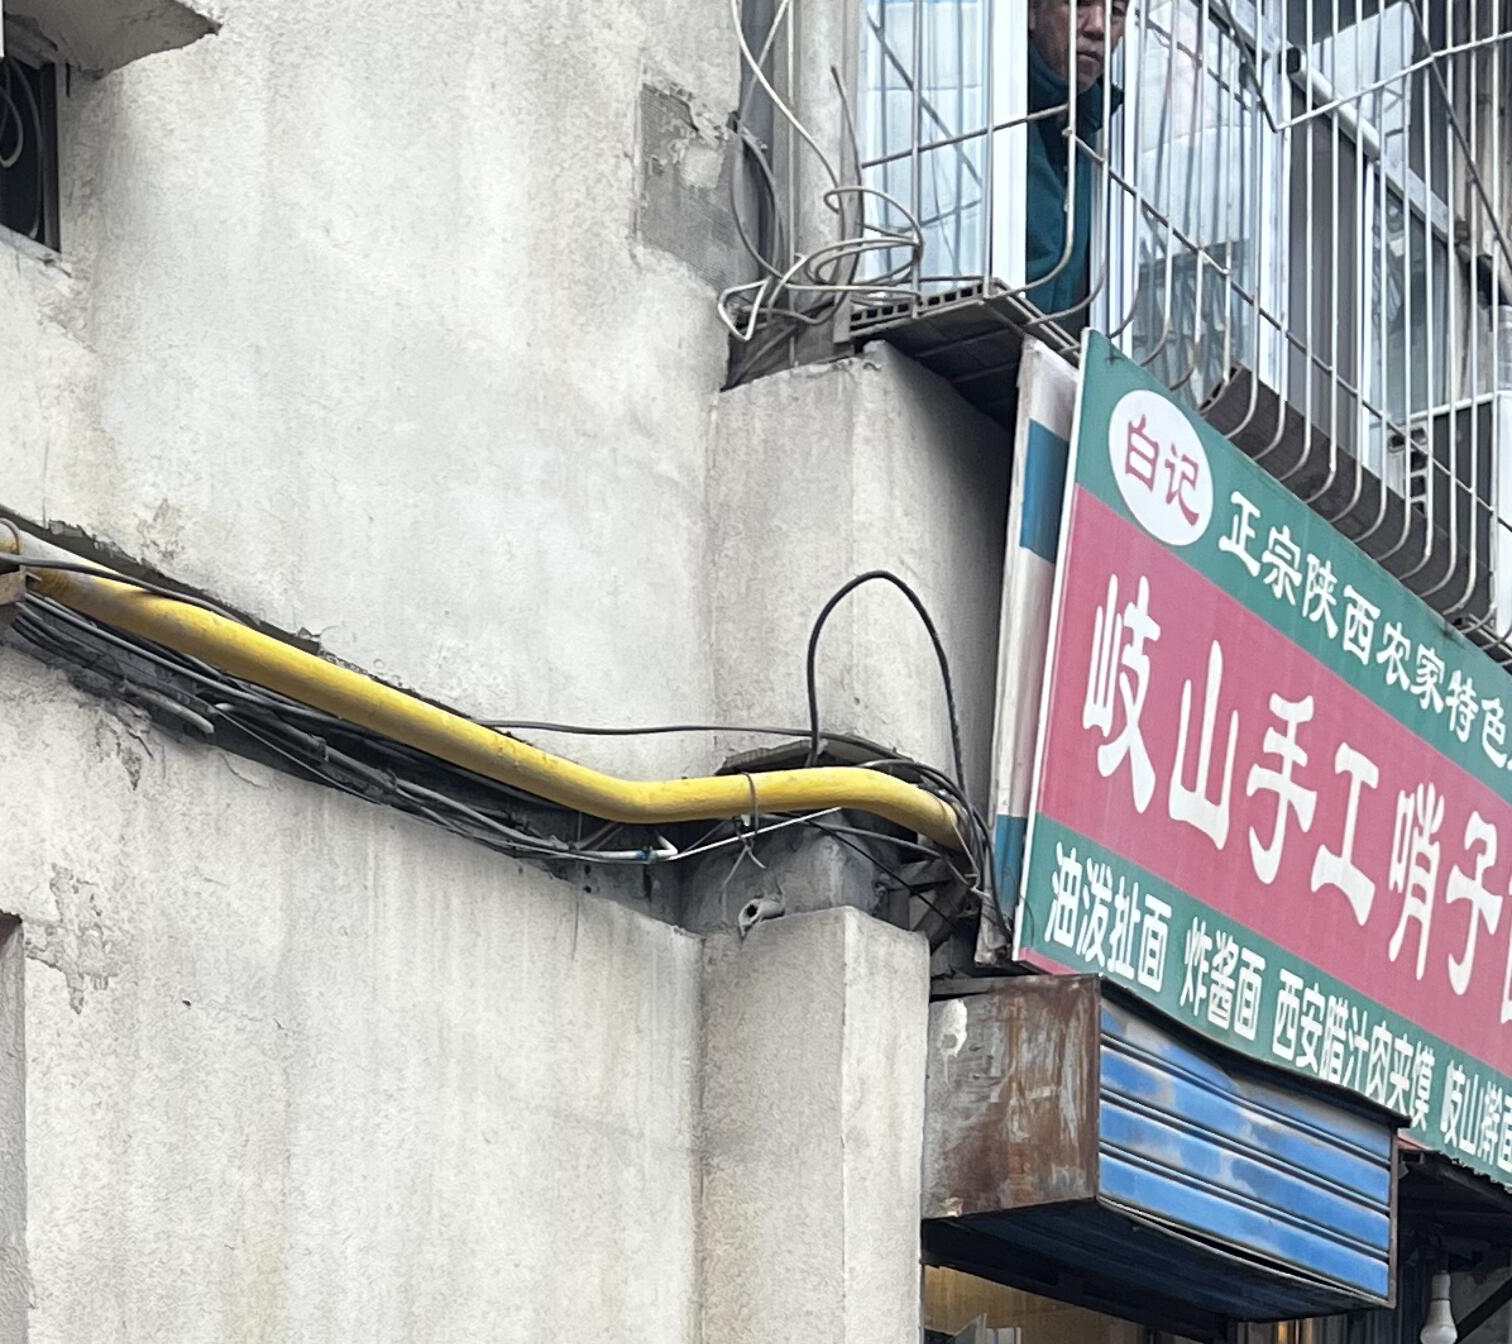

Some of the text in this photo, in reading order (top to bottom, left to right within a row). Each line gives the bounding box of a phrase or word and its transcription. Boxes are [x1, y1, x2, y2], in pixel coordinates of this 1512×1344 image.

[1125, 414, 1199, 526] 白记
[1219, 491, 1512, 770] 正宗陕西农家特色
[1082, 573, 1512, 1023] 岐山手工哨子
[1044, 842, 1172, 993] 油泼扯面
[1180, 916, 1265, 1041] 炸酱面
[1271, 969, 1435, 1131] 西安腊汁肉夹馍
